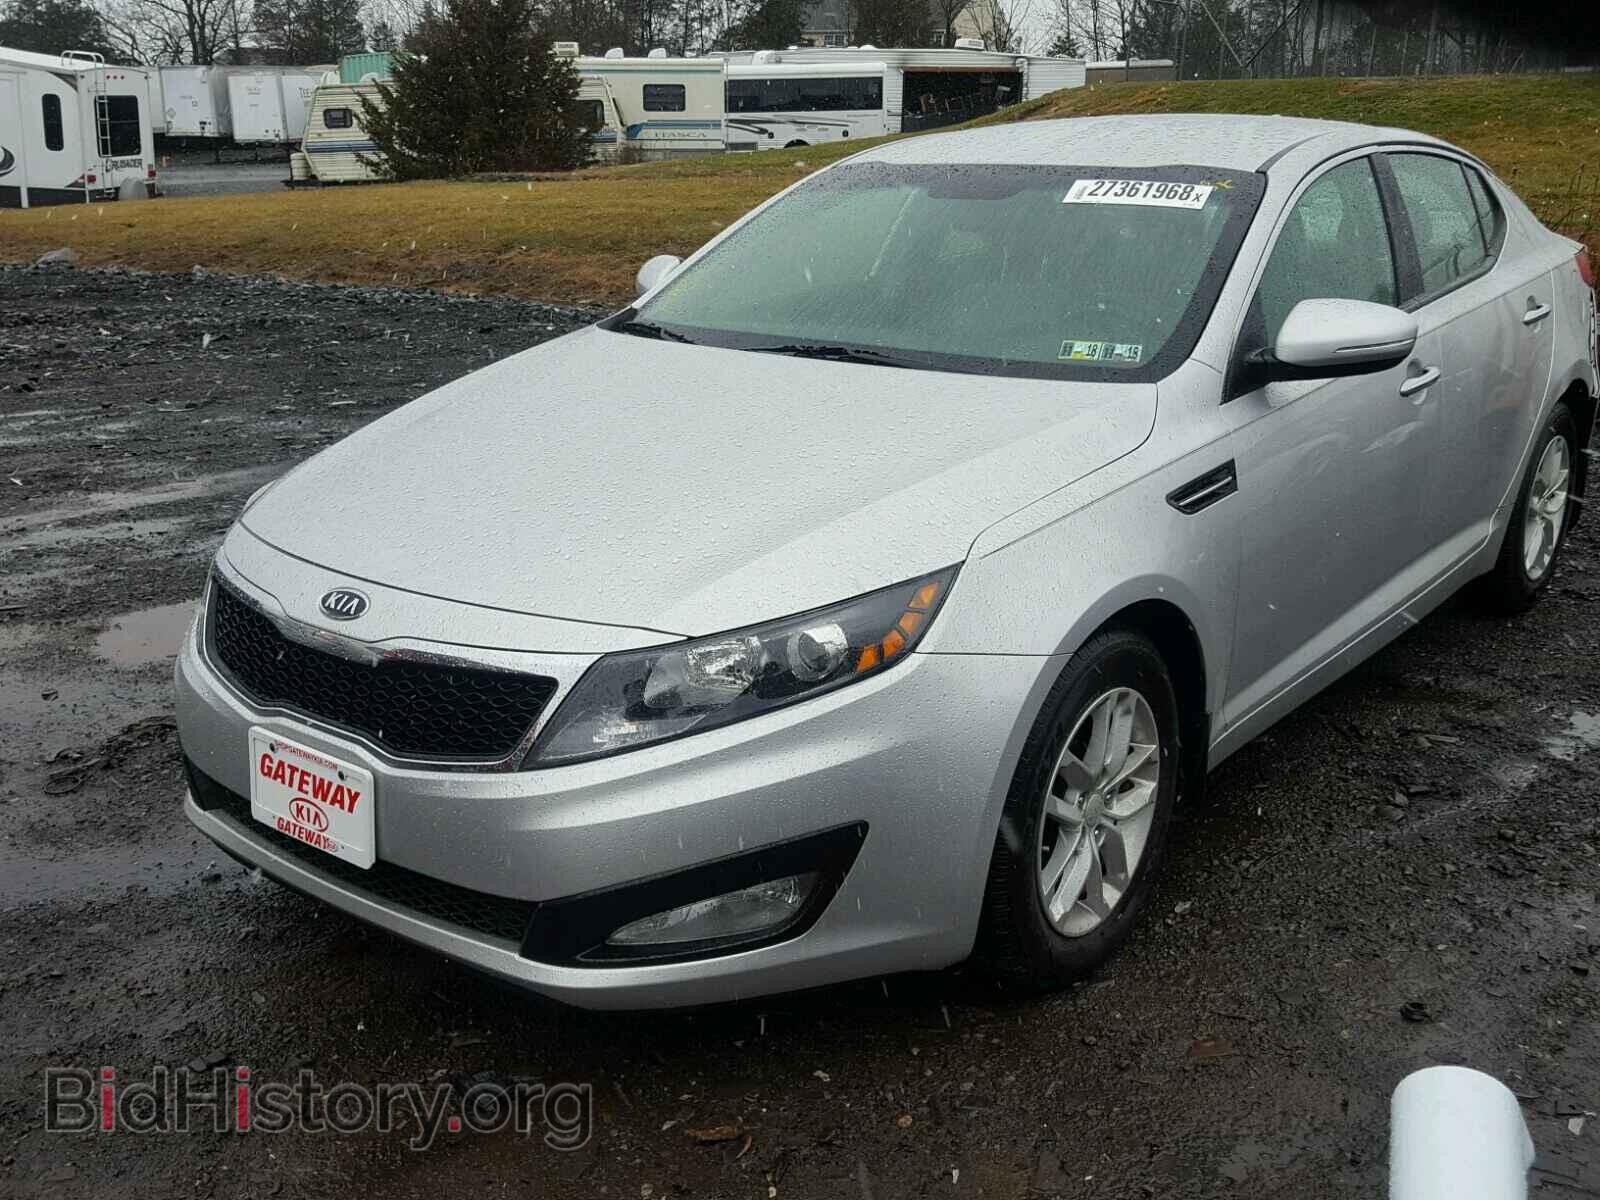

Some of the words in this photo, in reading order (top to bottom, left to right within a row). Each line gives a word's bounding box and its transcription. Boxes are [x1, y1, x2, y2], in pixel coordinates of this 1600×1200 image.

[655, 131, 707, 139] ITASCA
[106, 158, 143, 172] CRUSADER
[324, 591, 360, 615] KIA
[259, 752, 361, 815] GATEWAY
[295, 802, 322, 829] KIA
[276, 816, 331, 850] GATEWAY
